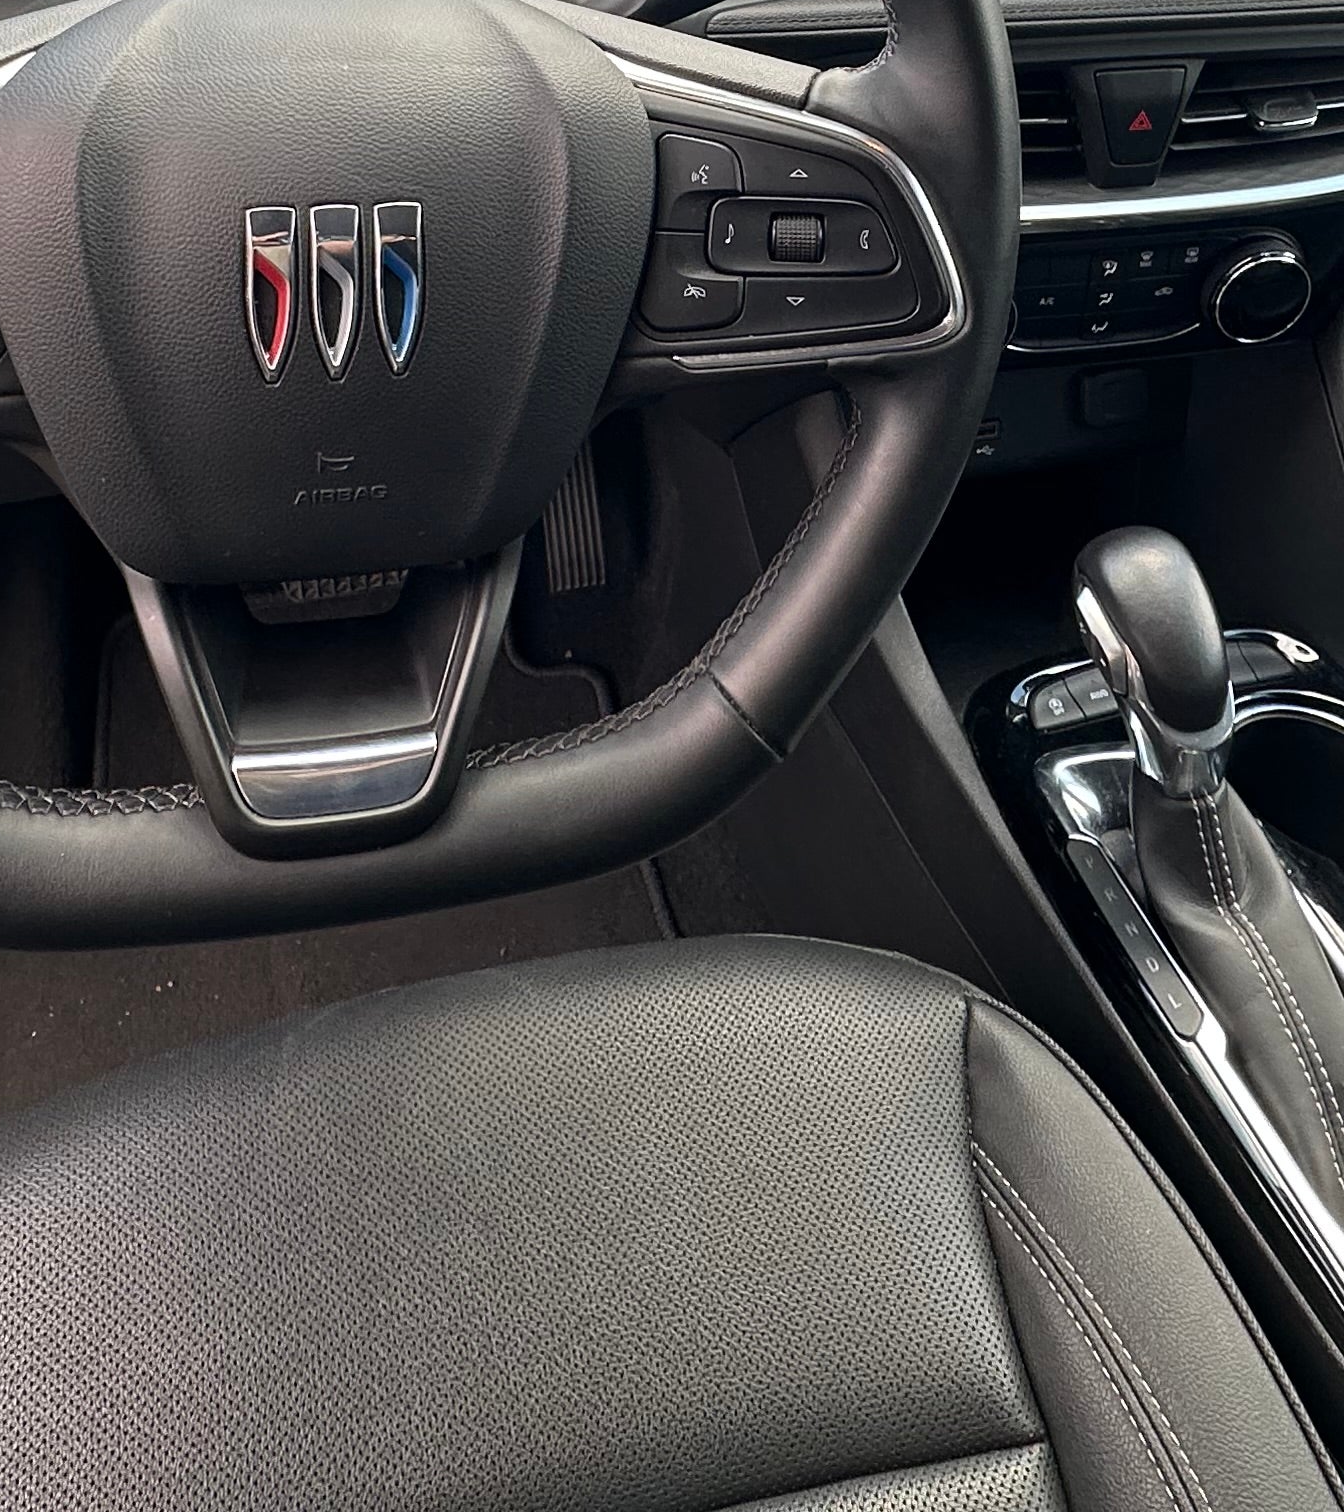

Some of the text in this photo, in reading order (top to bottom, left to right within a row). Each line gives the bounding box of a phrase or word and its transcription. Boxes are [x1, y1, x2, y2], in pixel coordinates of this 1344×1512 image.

[294, 485, 388, 505] AIRBAG
[1124, 922, 1139, 937] N
[1145, 957, 1159, 973] D
[1167, 993, 1182, 1009] L
